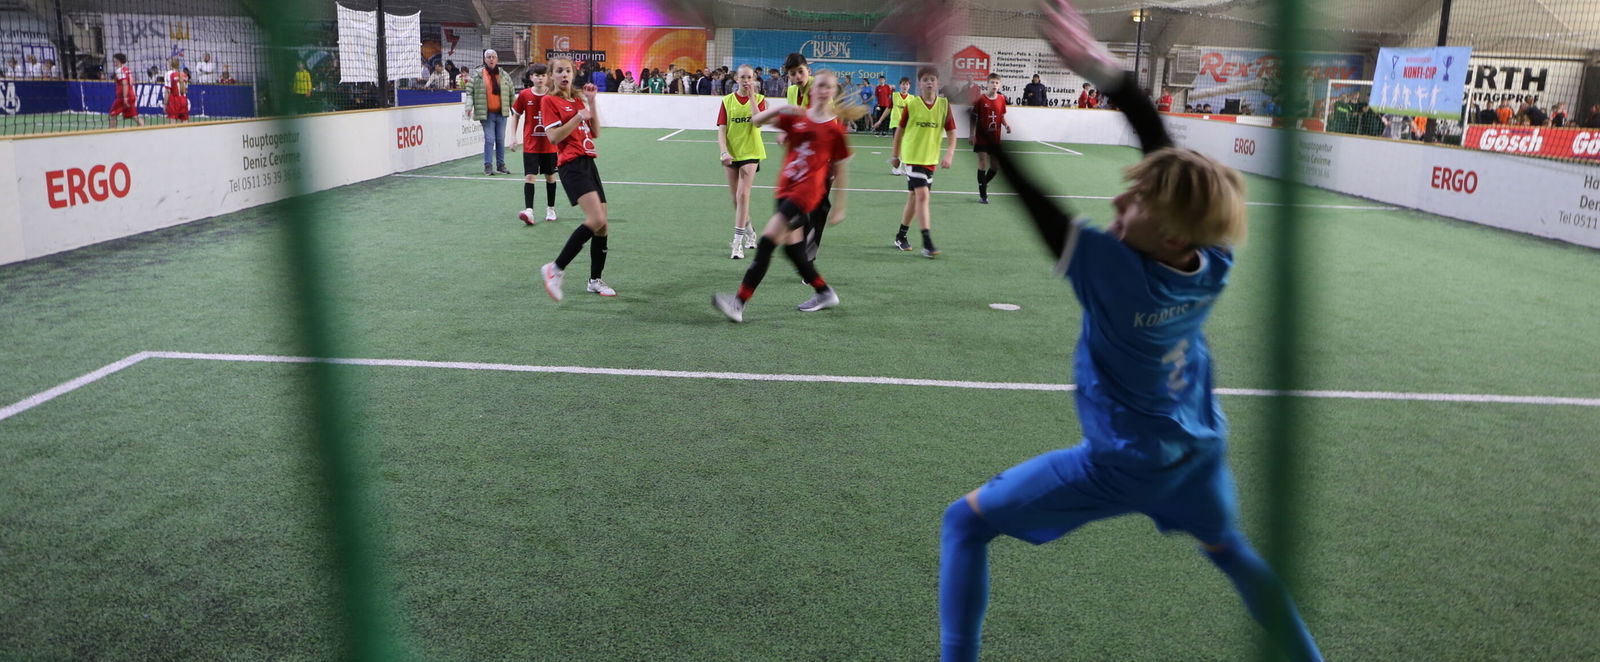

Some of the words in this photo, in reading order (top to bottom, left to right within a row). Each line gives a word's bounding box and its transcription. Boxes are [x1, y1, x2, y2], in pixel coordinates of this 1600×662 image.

[954, 57, 988, 70] GFH
[1403, 65, 1437, 80] KONFI-CUP
[653, 81, 660, 90] 7
[396, 124, 424, 149] ERGO
[1233, 137, 1256, 156] ERGO
[1479, 128, 1544, 153] Gösch
[243, 152, 268, 171] Deniz
[45, 161, 131, 209] ERGO
[229, 178, 241, 193] Tel
[241, 175, 261, 191] 0511
[262, 172, 272, 187] 35
[273, 170, 282, 185] 39
[1431, 166, 1478, 194] ERGO
[1559, 210, 1573, 225] Tel
[1573, 215, 1598, 230] 0511
